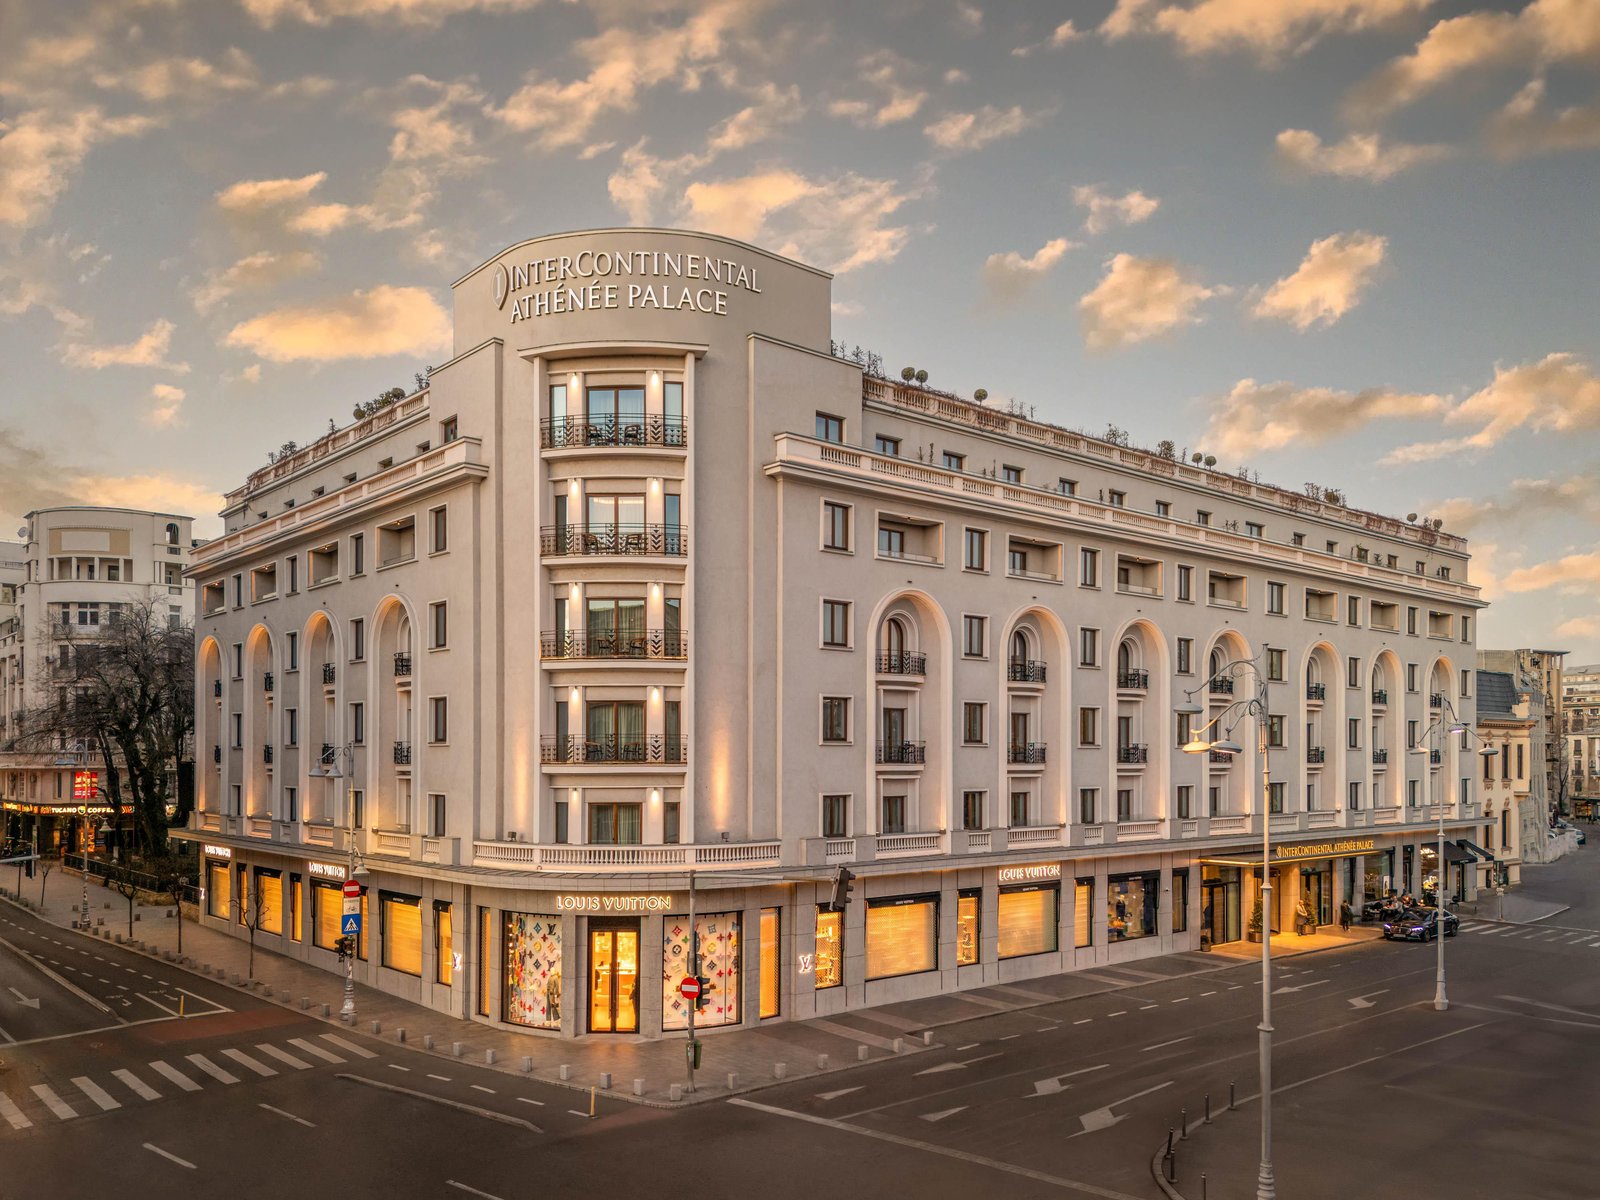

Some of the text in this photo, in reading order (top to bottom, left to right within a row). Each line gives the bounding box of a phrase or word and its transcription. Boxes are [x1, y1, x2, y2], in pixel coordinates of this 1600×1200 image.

[510, 250, 762, 293] INTERCONTINENTAL
[510, 280, 728, 323] ATHÉNÉE PALACE
[52, 806, 77, 814] TUCANO
[1356, 840, 1374, 850] PALACE
[999, 865, 1060, 881] LOUIS VUITTON
[557, 896, 671, 910] LOUIS VUITTON
